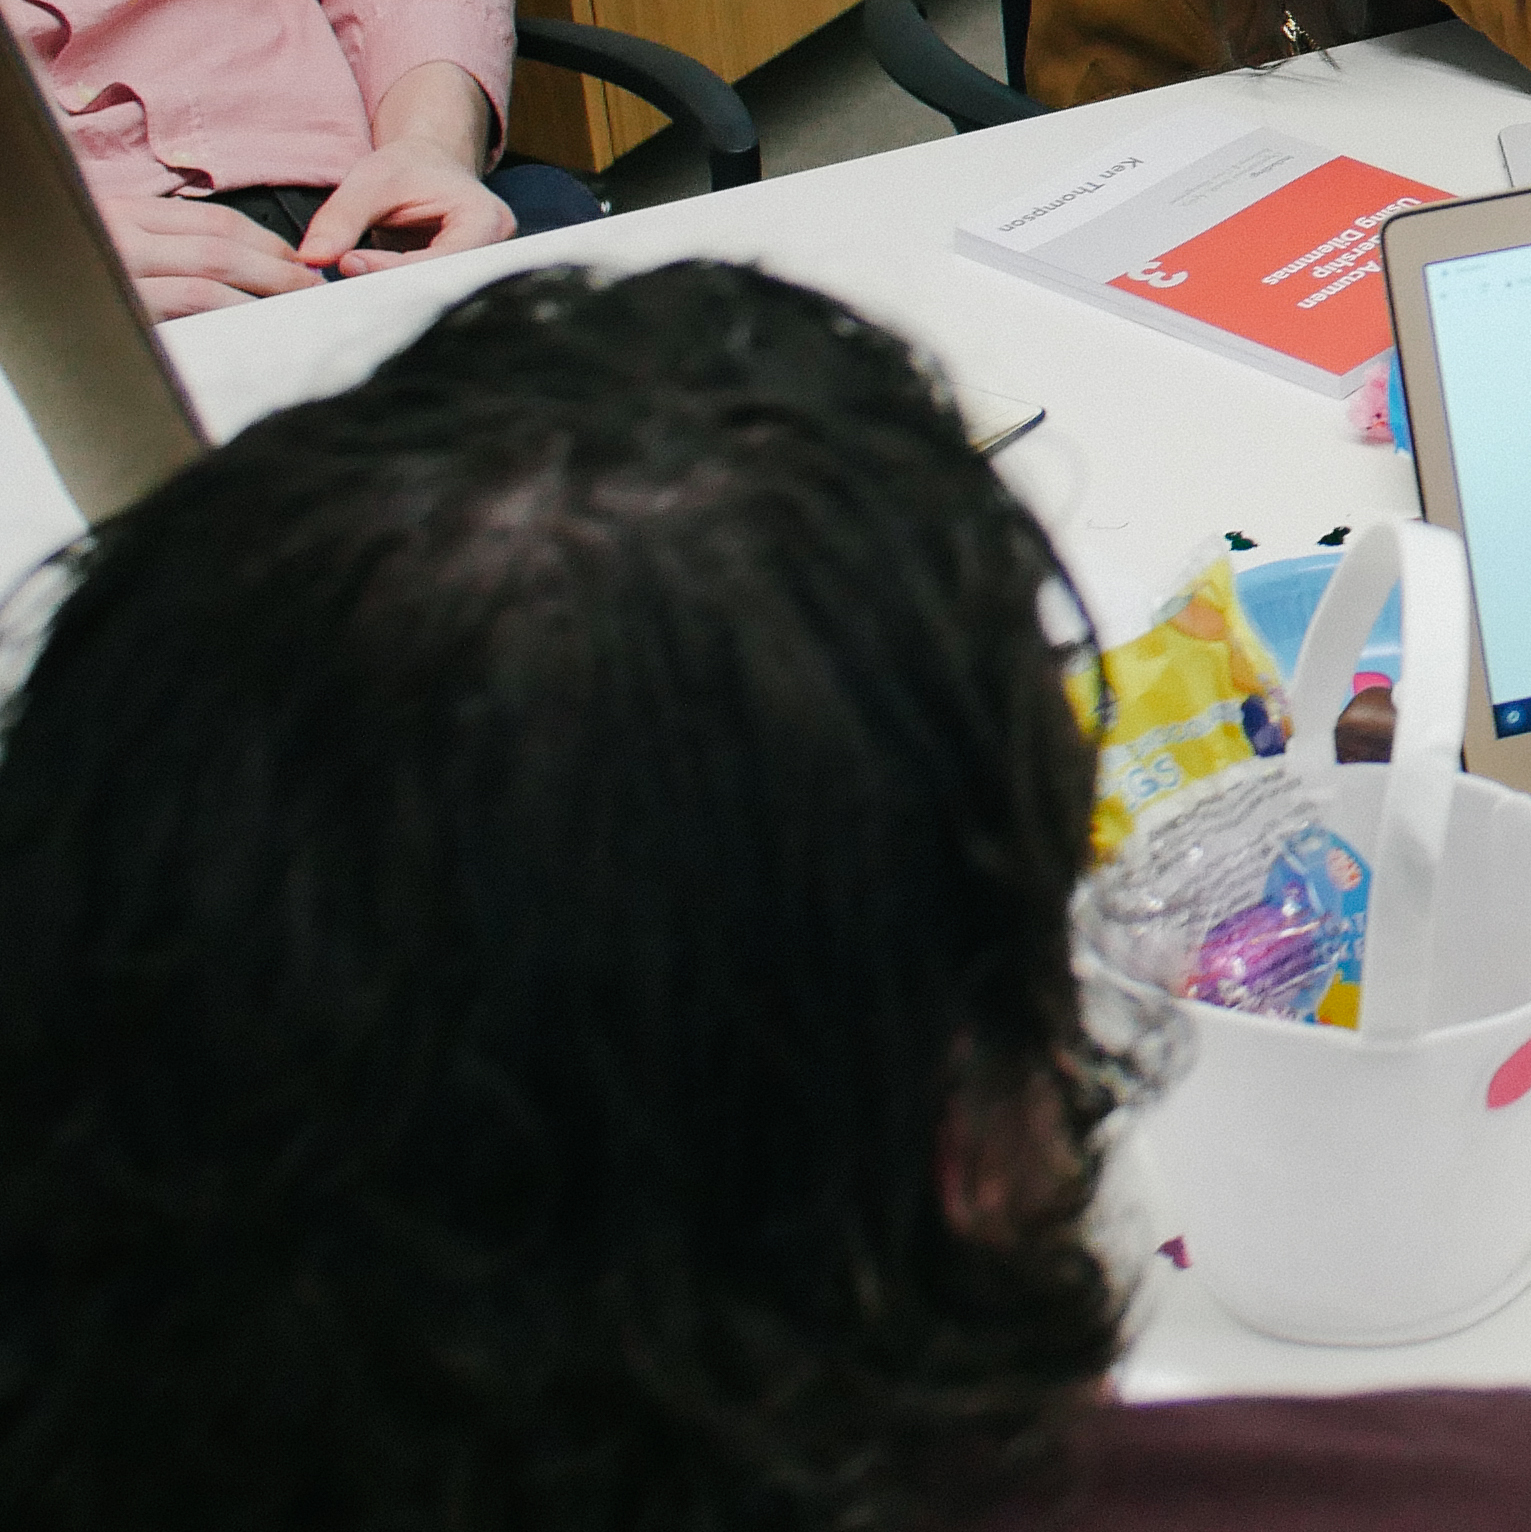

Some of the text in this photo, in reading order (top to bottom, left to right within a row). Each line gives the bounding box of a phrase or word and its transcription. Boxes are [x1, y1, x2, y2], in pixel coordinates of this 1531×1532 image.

[1099, 156, 1145, 179] Ken
[998, 181, 1106, 232] Thompson
[1260, 197, 1423, 286] Using Dilemmas
[1296, 259, 1382, 309] Acumen
